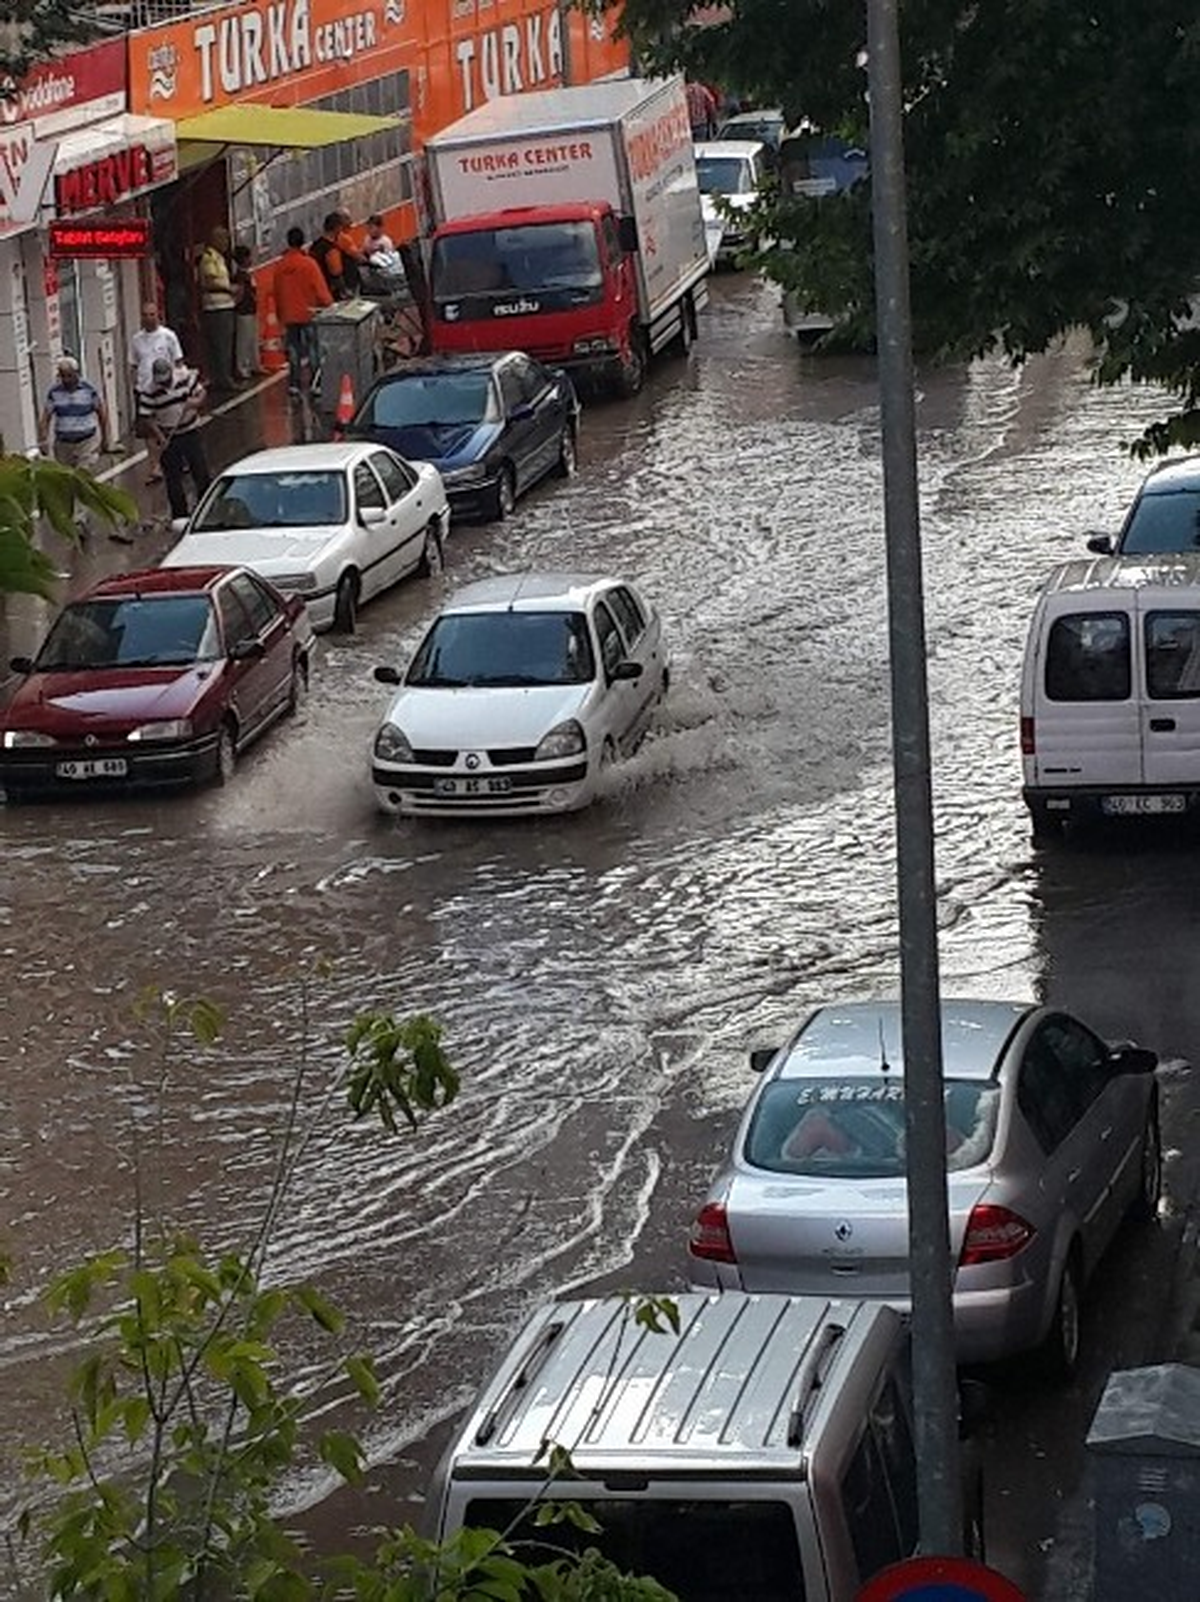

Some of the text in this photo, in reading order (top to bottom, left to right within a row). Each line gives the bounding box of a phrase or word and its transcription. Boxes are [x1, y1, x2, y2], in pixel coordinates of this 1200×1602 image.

[194, 0, 377, 102] TURKA CENTER
[457, 8, 563, 110] TURKA
[458, 154, 520, 173] TURKA
[524, 142, 593, 165] CENTER
